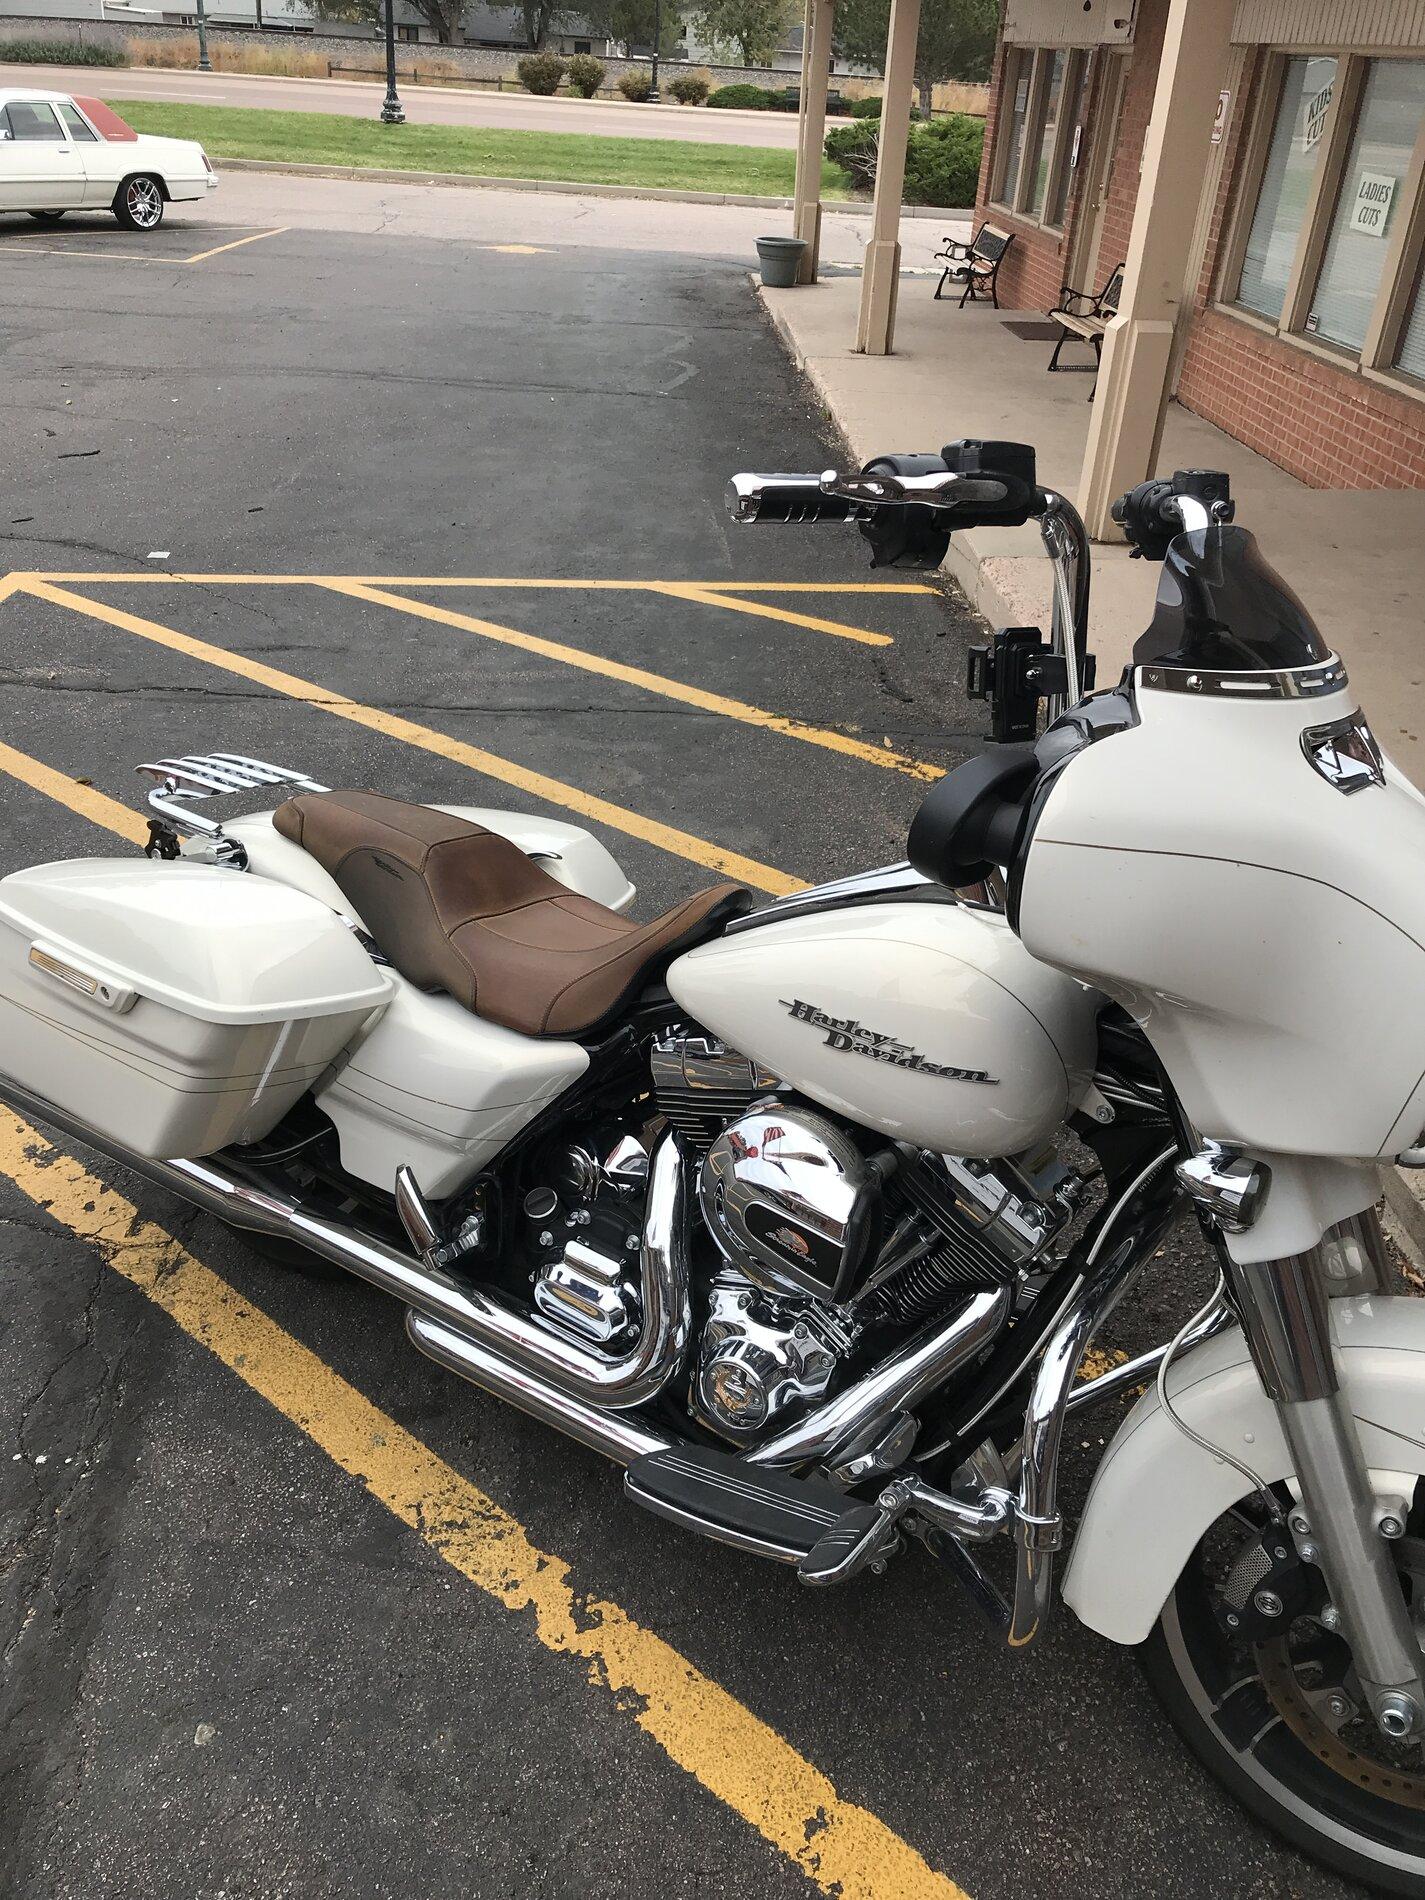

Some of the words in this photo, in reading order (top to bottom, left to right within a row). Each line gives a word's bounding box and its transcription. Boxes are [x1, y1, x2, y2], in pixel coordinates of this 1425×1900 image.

[1358, 180, 1392, 203] LADIES
[1357, 206, 1382, 227] CUTS
[779, 999, 914, 1050] Harley
[822, 1029, 1000, 1085] Davidson
